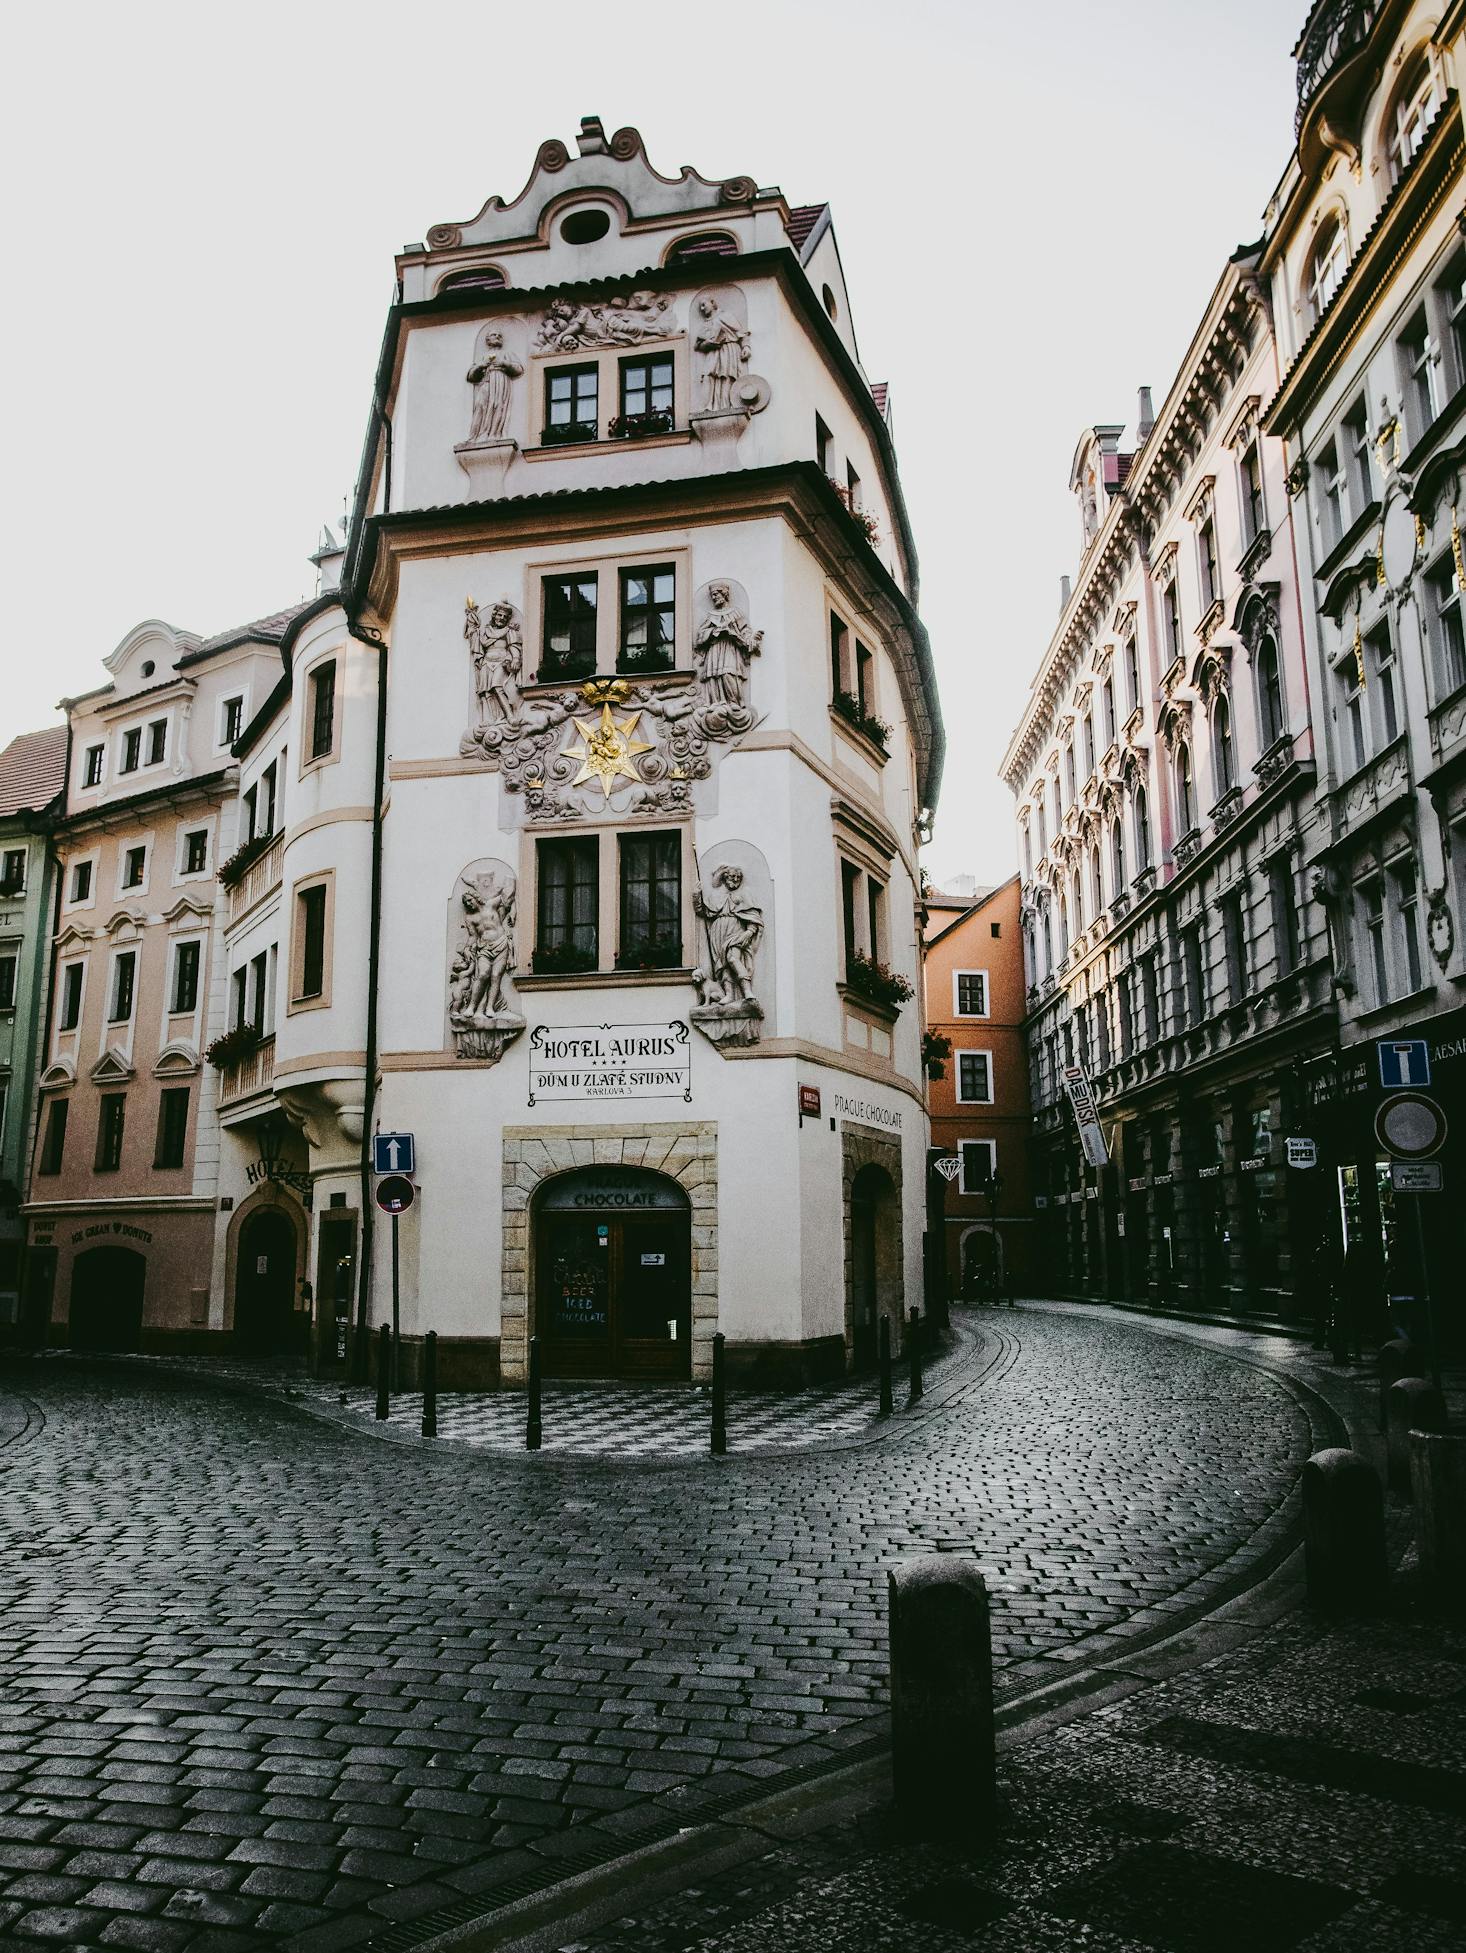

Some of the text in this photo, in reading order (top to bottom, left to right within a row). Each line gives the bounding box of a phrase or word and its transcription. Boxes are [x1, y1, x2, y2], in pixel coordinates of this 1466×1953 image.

[544, 1038, 675, 1059] HOTEL AURUS
[1431, 1038, 1466, 1063] AESA
[537, 1070, 684, 1088] DŮM U ZLATÉ STUDNY
[585, 1087, 625, 1096] KARLOVA
[834, 1094, 864, 1118] PRAGUE
[865, 1104, 902, 1129] CHOCOLATE
[1074, 1097, 1096, 1128] DISK
[1290, 1149, 1314, 1157] SUPER
[245, 1159, 295, 1185] HOEL
[574, 1193, 656, 1206] CHOCOLATE
[122, 1224, 153, 1244] DONUTS
